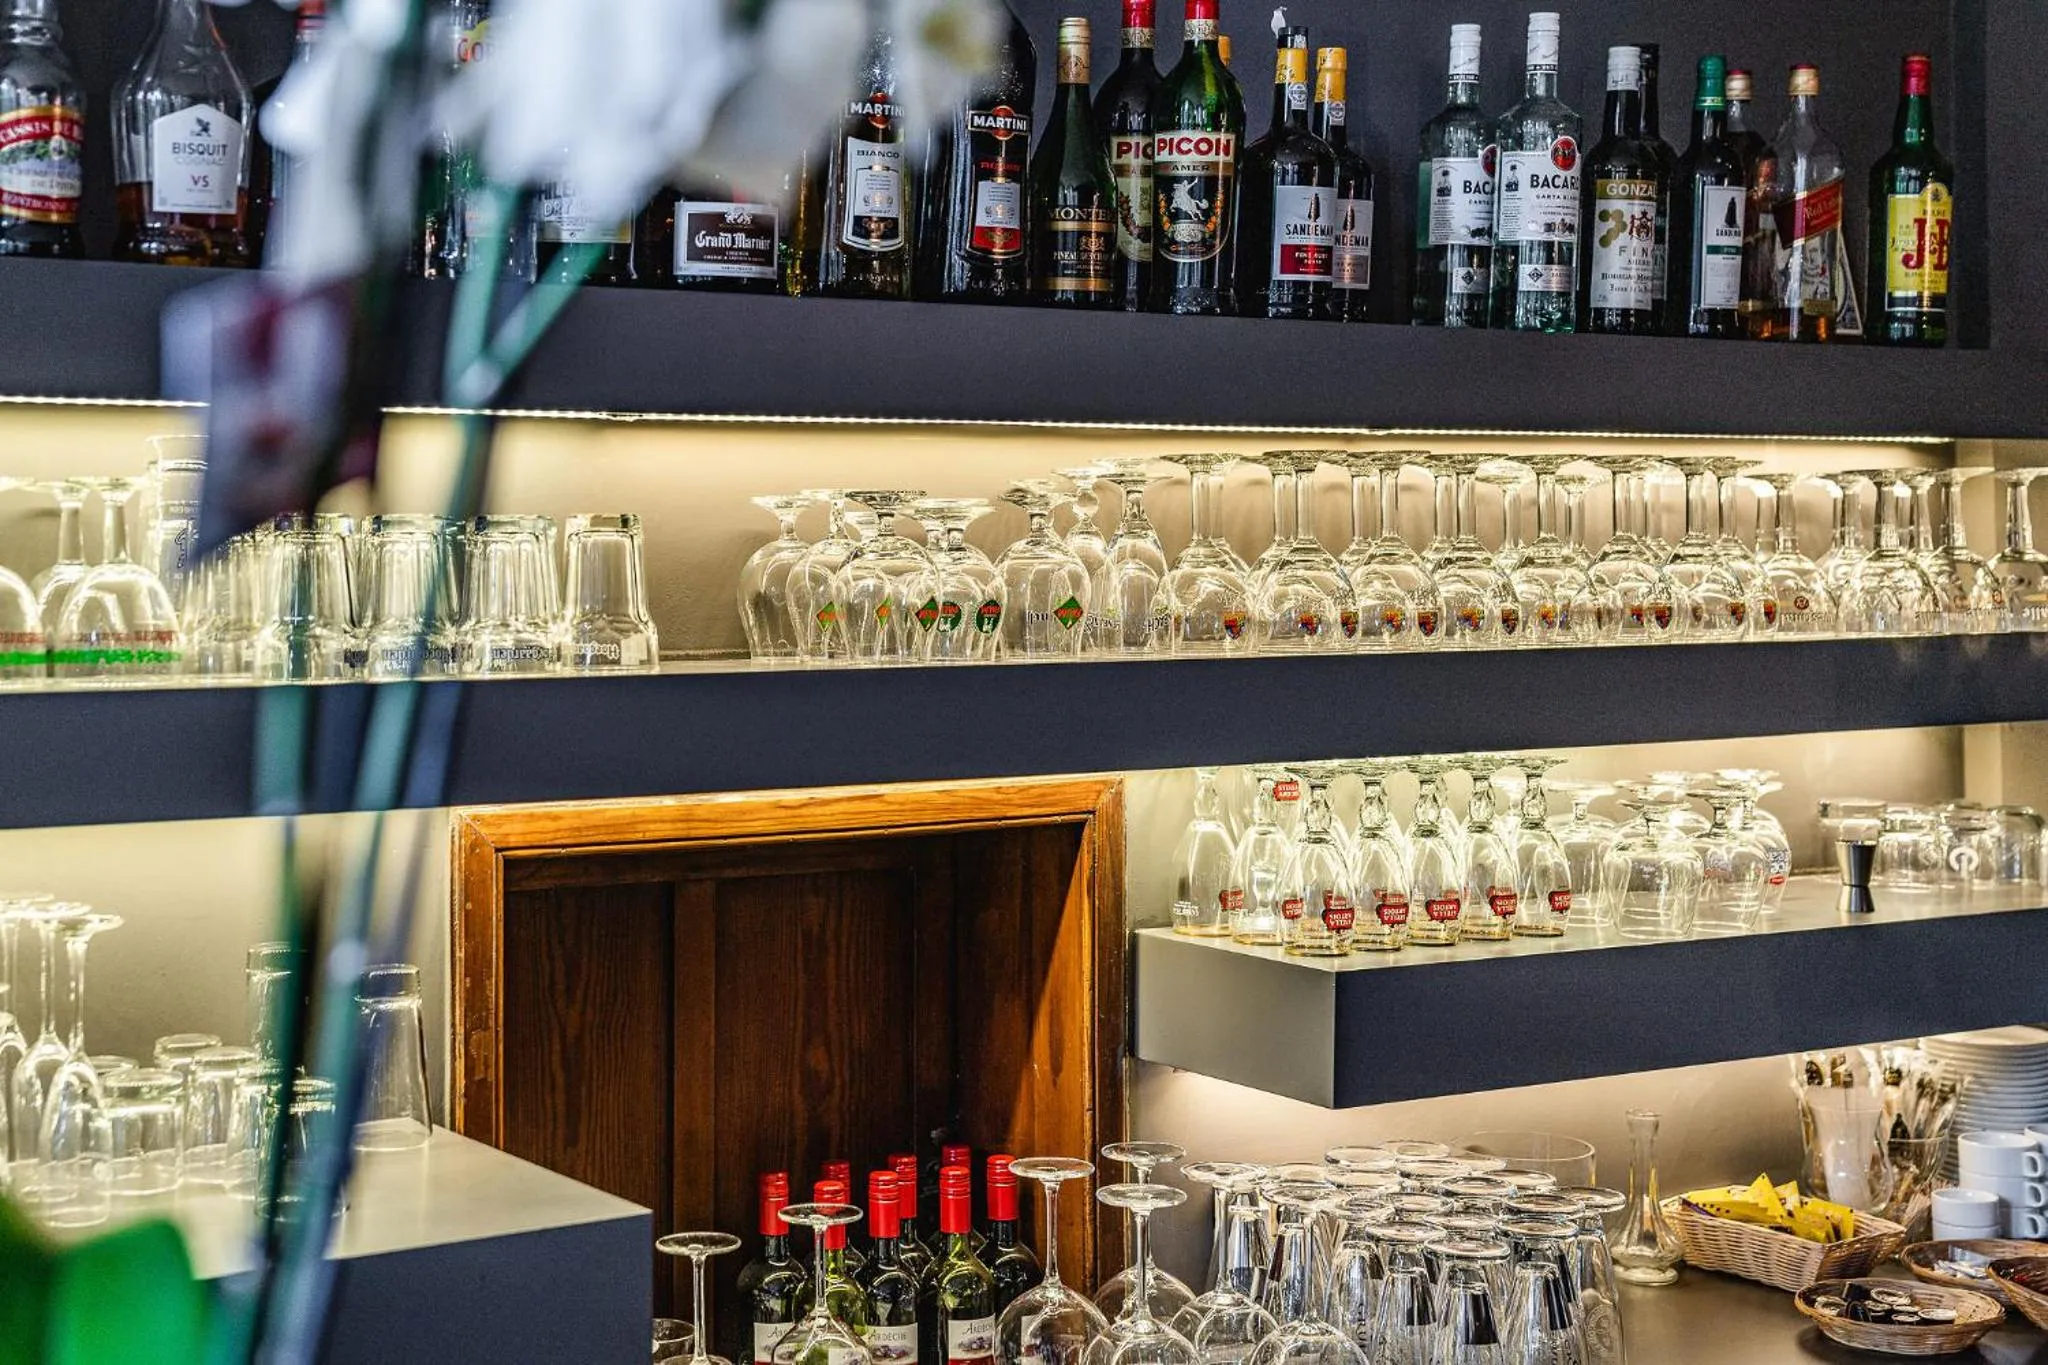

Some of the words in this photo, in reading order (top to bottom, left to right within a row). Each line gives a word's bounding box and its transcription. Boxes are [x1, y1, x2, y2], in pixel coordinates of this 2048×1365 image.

[972, 115, 1027, 131] MARTINI
[172, 142, 228, 156] BISQUIT
[1157, 137, 1231, 157] PICON
[857, 150, 900, 159] BIANCO
[1171, 164, 1210, 172] AMER
[191, 174, 210, 188] VS
[694, 230, 732, 248] Grand
[733, 232, 771, 250] Marnier
